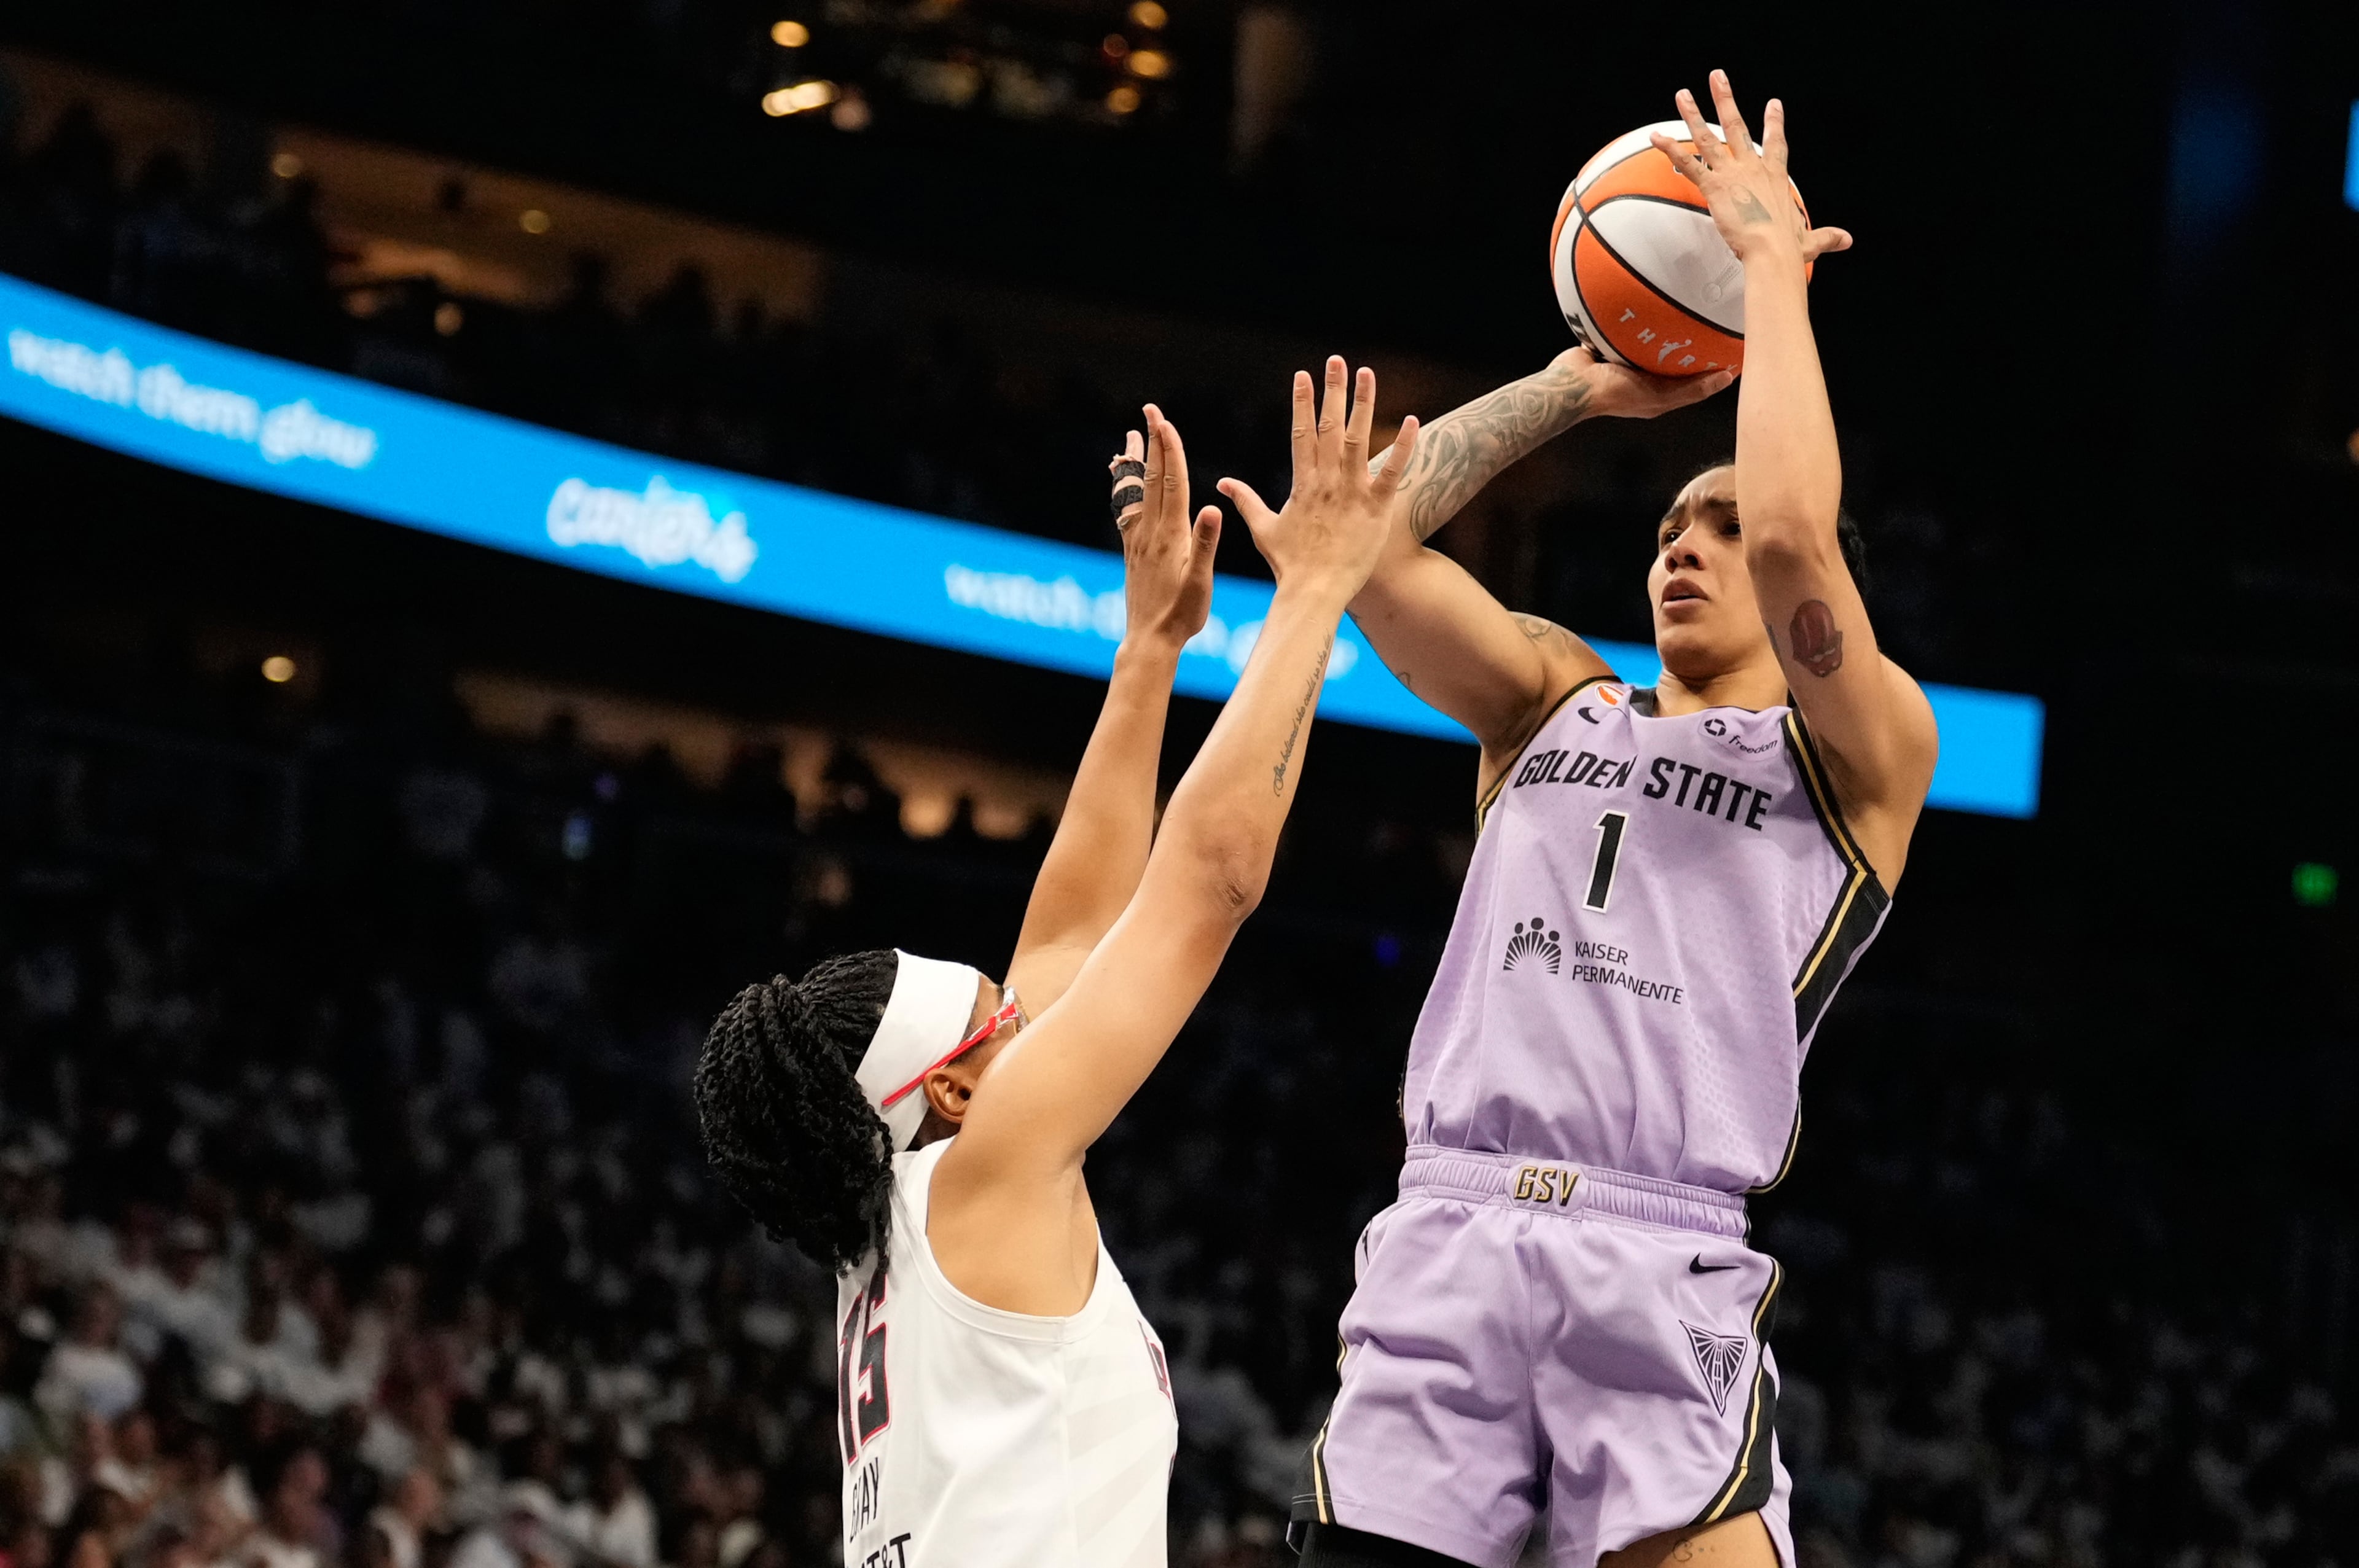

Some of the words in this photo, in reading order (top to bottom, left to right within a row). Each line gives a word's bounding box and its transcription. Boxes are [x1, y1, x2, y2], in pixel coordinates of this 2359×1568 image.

[8, 329, 135, 408] watch
[136, 364, 260, 443] them
[259, 397, 377, 469] glow
[944, 563, 1092, 633] watch
[1728, 734, 1778, 755] freedom
[1513, 749, 1638, 790] GOLDEN
[1642, 756, 1772, 831] STATE
[1581, 808, 1630, 914] 1
[1575, 941, 1629, 965] KAISER
[1571, 965, 1684, 1005] PERMANENTE
[1512, 1166, 1579, 1207] GSV
